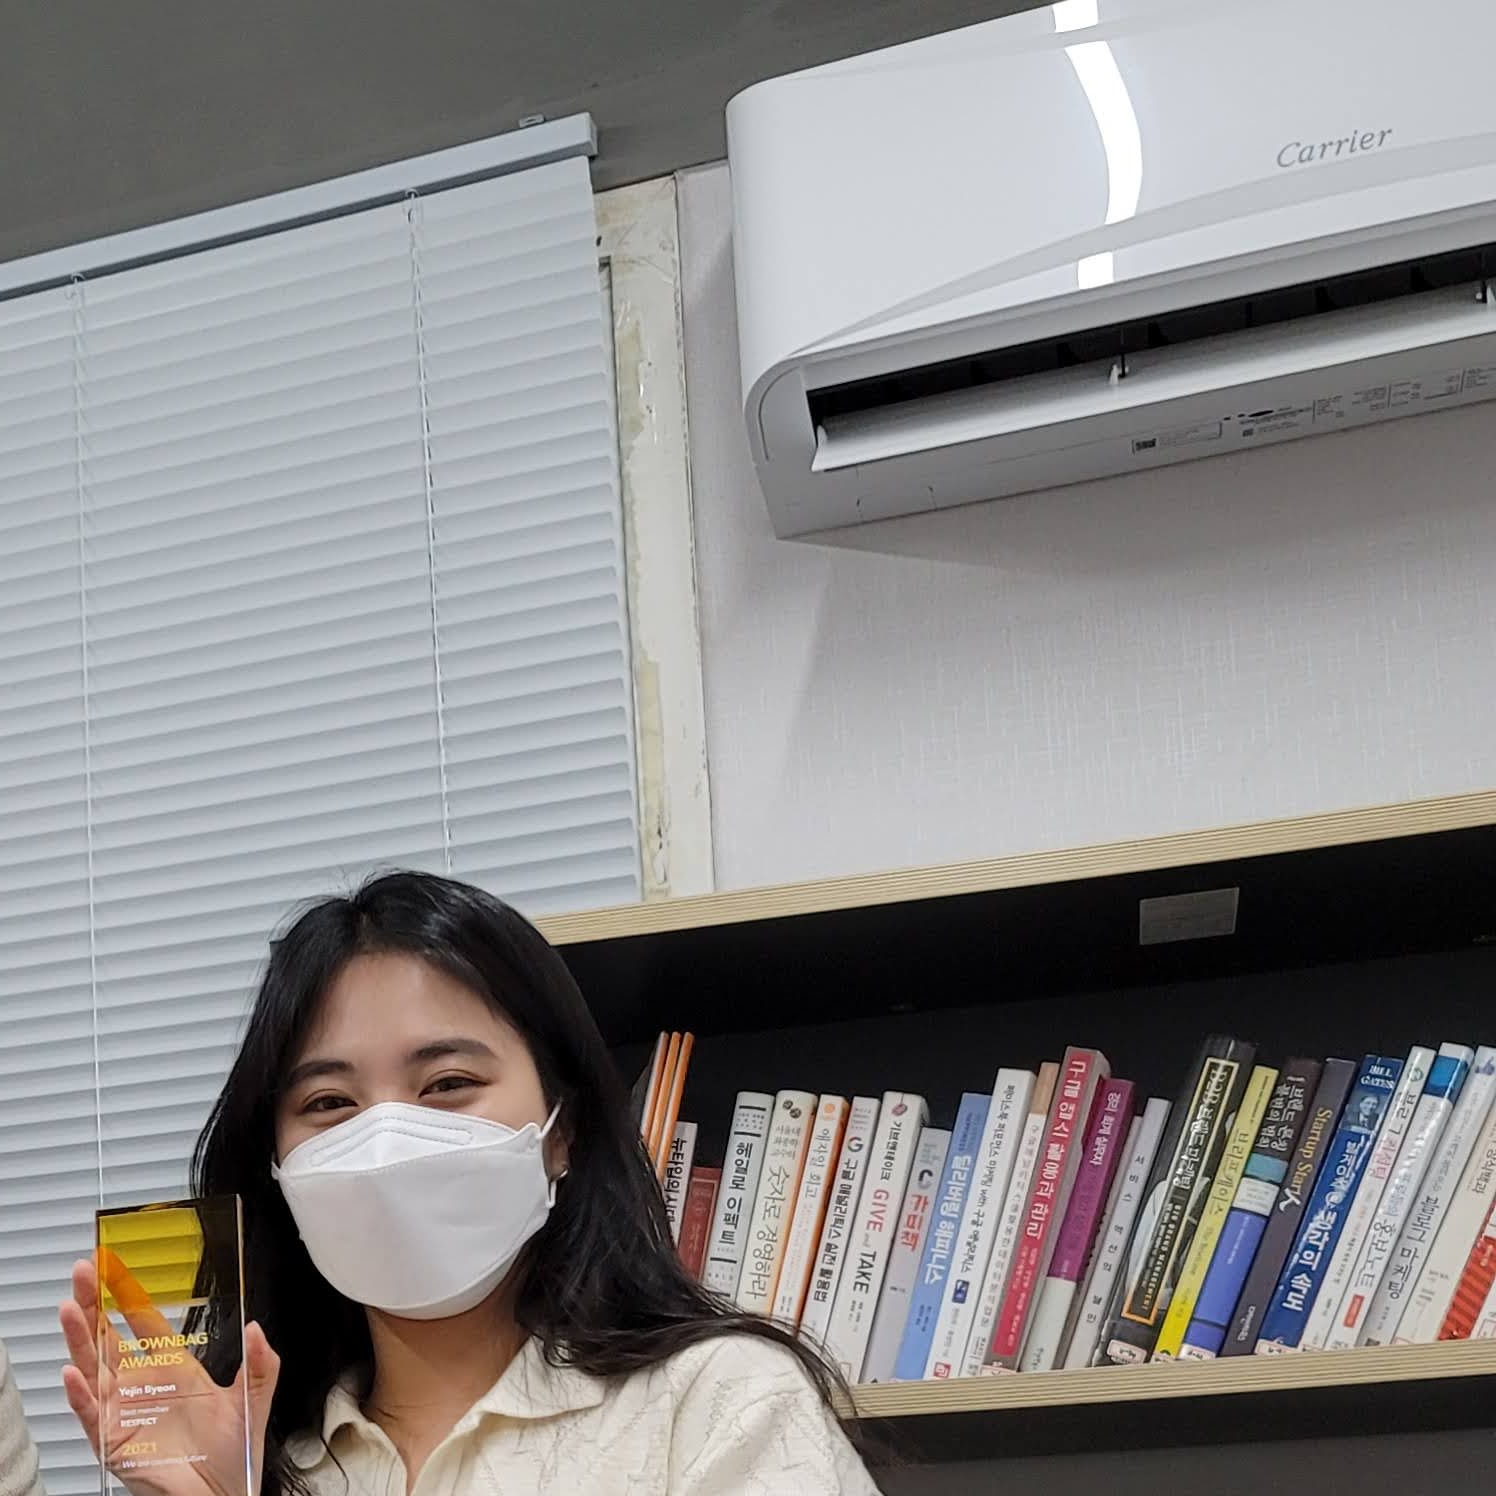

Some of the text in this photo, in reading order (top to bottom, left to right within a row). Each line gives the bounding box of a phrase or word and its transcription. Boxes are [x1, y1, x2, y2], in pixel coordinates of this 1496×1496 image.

[1276, 128, 1393, 169] Carrier
[1062, 1058, 1086, 1099] 구글
[1359, 1071, 1395, 1093] GATES
[1368, 1063, 1394, 1079] BILL
[996, 1083, 1015, 1121] 페이스북
[1051, 1100, 1074, 1137] 앱스
[1280, 1084, 1308, 1125] 브랜드
[879, 1120, 902, 1181] 기브앤테이크
[1301, 1106, 1331, 1160] Startup
[728, 1141, 753, 1191] 헤일로
[803, 1126, 832, 1200] 애자일 회고
[980, 1159, 996, 1187] 마케팅
[1207, 1128, 1250, 1217] 브리프케이스
[865, 1188, 889, 1232] GIVE
[971, 1208, 985, 1228] 구글
[975, 1188, 988, 1207] with
[743, 1163, 791, 1301] 숫자로 경영하라
[813, 1157, 858, 1302] 구글 애널리틱스 실전 활용법
[923, 1152, 972, 1287] 딜리버링 해피니스
[852, 1249, 876, 1293] TAKE
[1354, 1216, 1395, 1292] 홍보노트
[1384, 1243, 1416, 1300] 마케팅
[1281, 1269, 1312, 1311] 속도
[118, 1332, 209, 1353] BROWNBAG
[118, 1352, 184, 1370] AWARDS
[119, 1383, 176, 1397] Yejin Byeon
[120, 1417, 158, 1428] RESPECT
[122, 1460, 136, 1469] We
[123, 1442, 157, 1456] 2021
